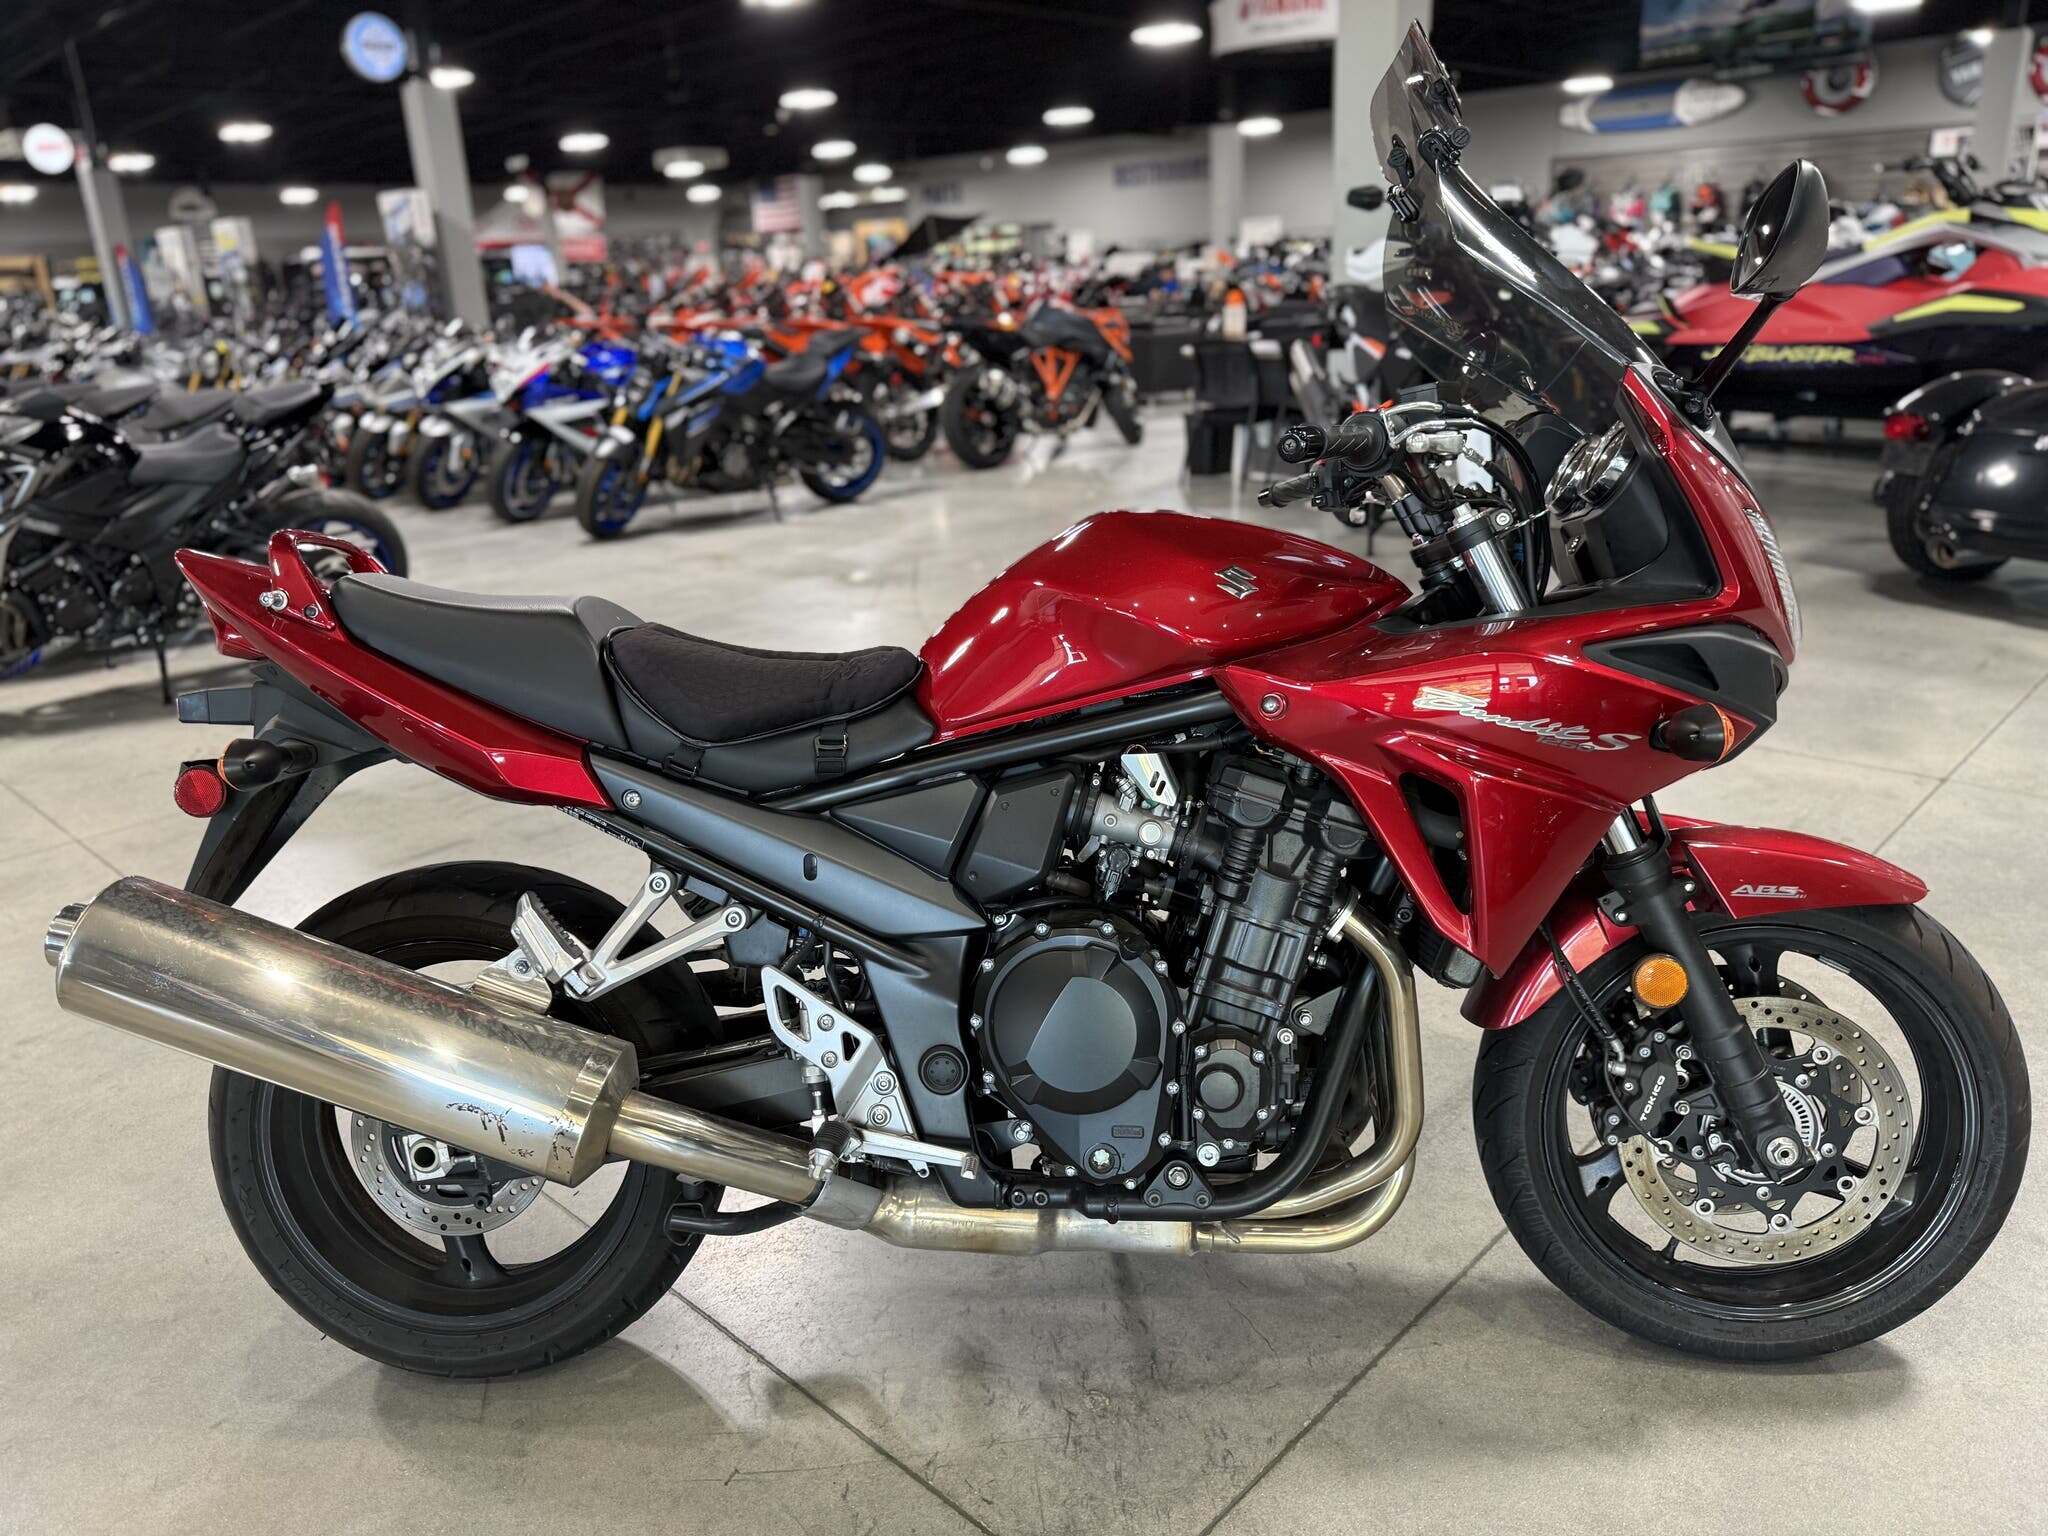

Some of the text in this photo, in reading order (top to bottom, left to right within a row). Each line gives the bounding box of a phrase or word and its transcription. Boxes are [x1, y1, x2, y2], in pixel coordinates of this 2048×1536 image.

[1412, 686, 1643, 751] Bandit S
[1730, 884, 1800, 897] ABS
[1639, 1074, 1666, 1121] TOKICO
